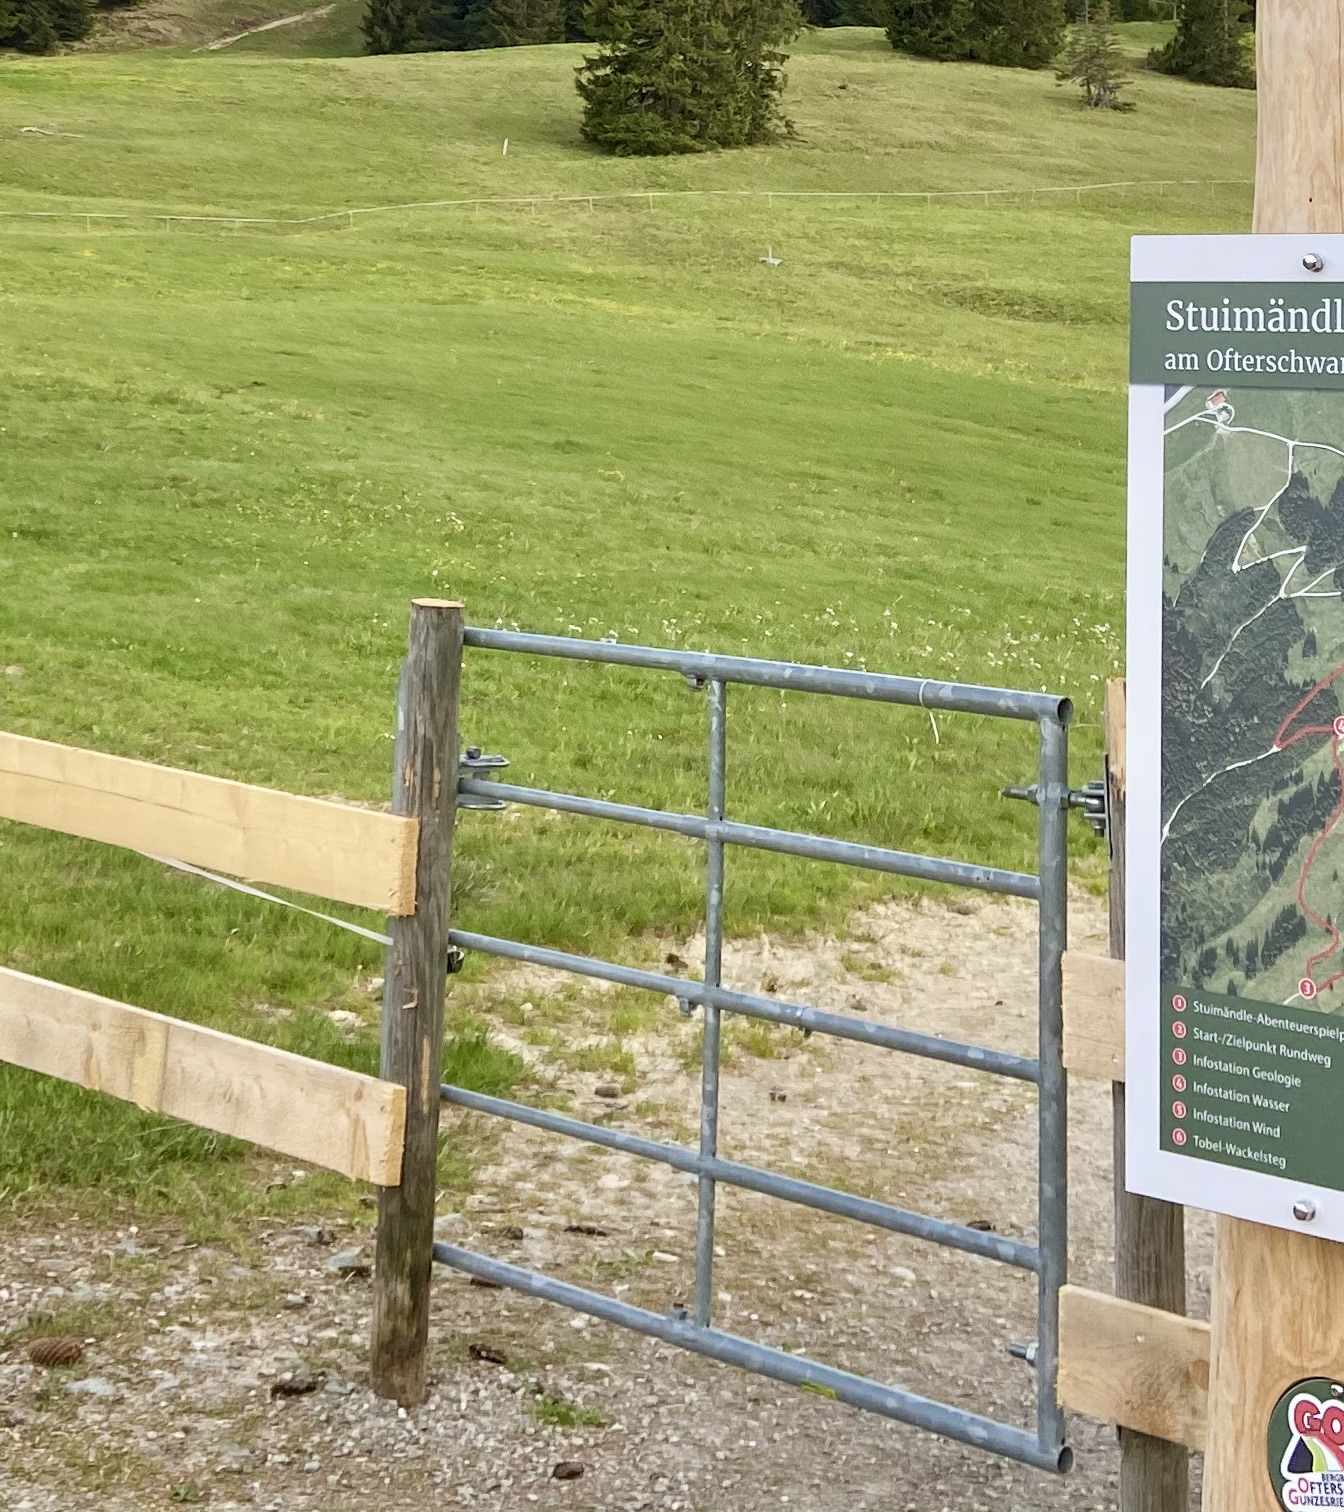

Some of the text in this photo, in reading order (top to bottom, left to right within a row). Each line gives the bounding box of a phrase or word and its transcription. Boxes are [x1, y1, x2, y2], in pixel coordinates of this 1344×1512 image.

[1164, 353, 1200, 370] am
[1279, 1044, 1331, 1068] Rundweg
[1193, 1054, 1302, 1087] Infostation Geologie
